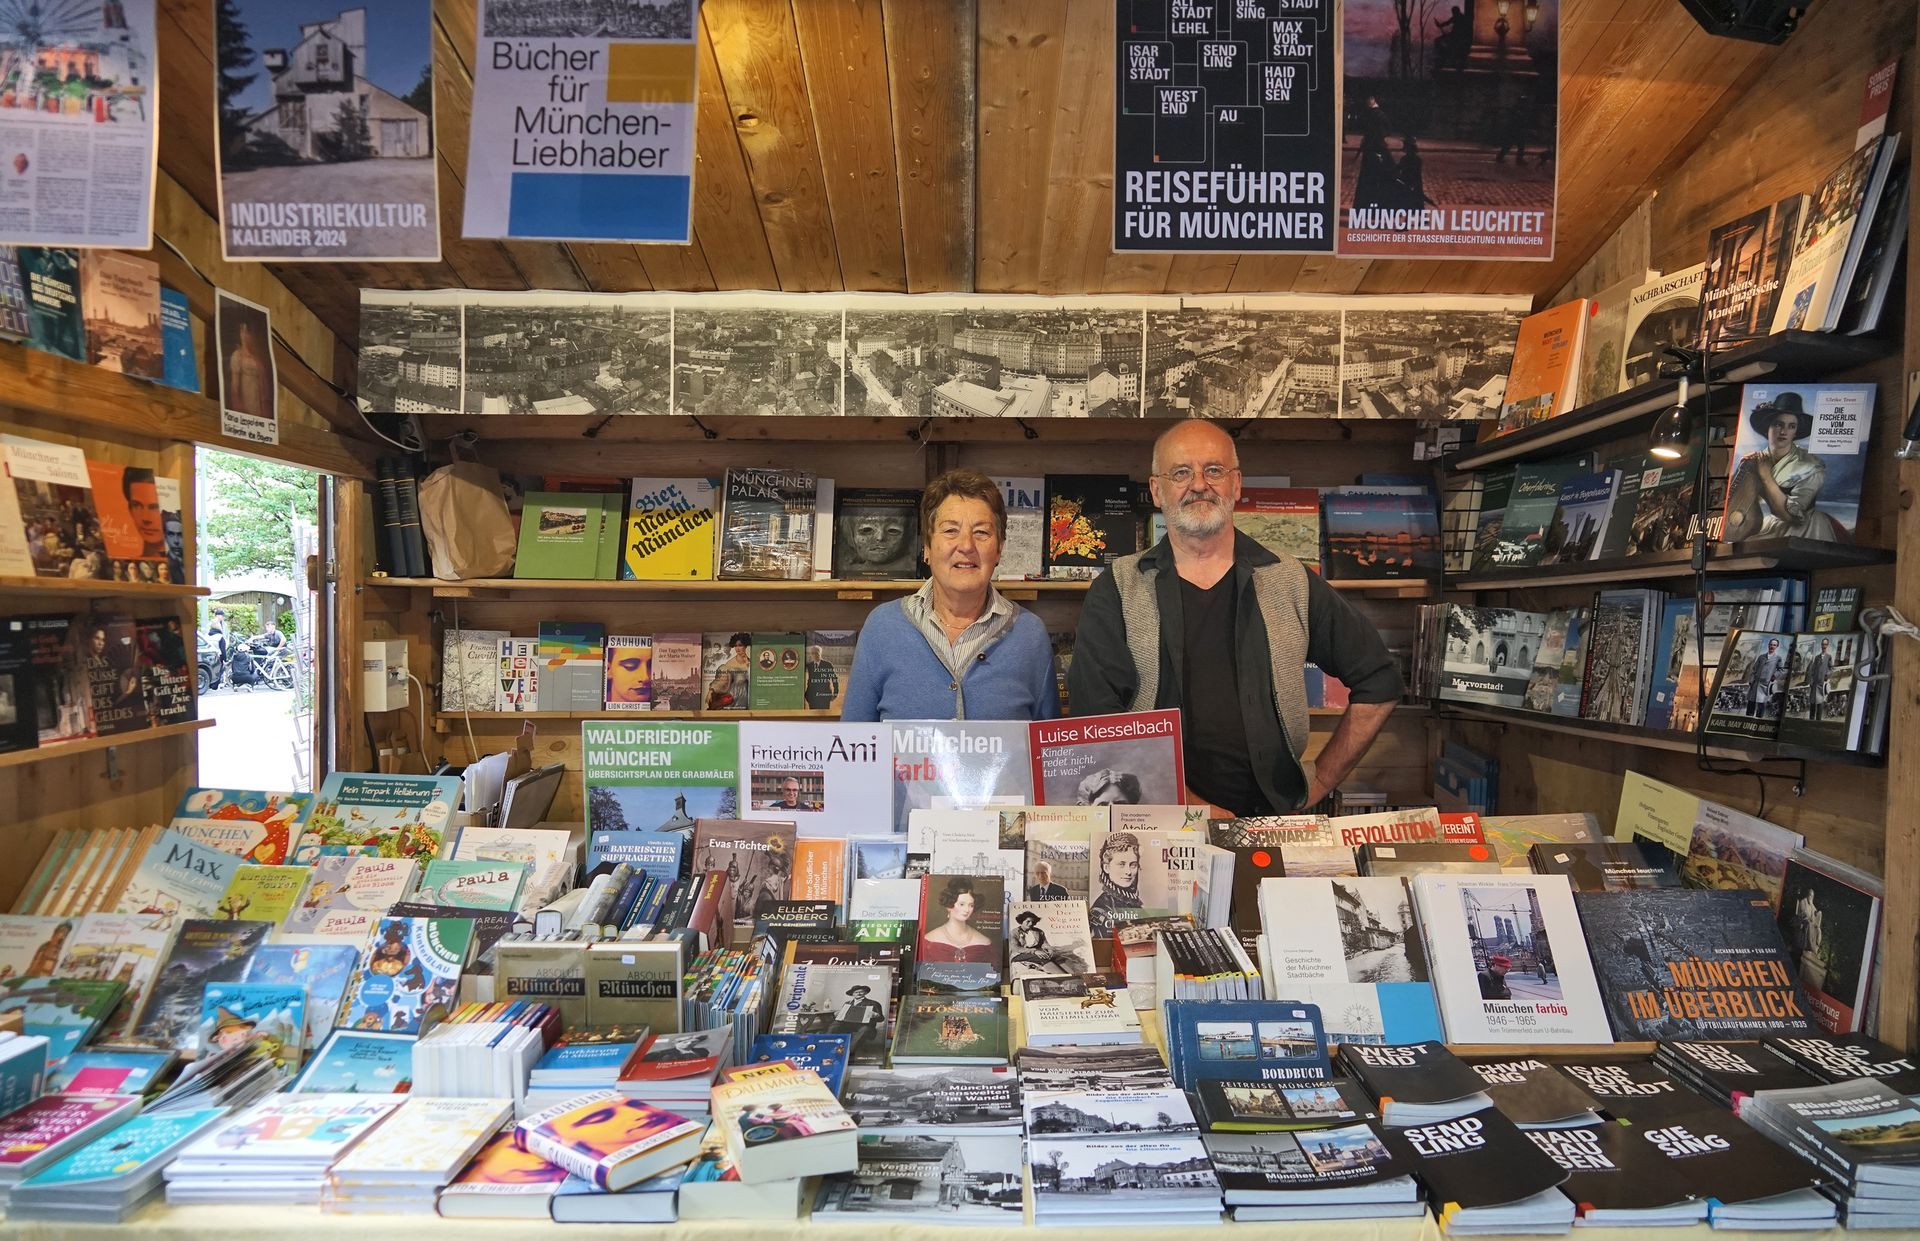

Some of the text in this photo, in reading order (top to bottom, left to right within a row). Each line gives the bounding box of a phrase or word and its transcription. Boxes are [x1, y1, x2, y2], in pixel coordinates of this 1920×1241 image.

[1172, 6, 1213, 18] STADT
[1236, 8, 1266, 19] SING
[1172, 22, 1208, 34] LEHEL
[1273, 22, 1302, 34] MAX
[1274, 33, 1298, 44] VOR
[492, 41, 600, 71] Bücher
[1130, 45, 1158, 57] ISAR
[1203, 45, 1237, 56] SEND
[1274, 45, 1314, 56] STADT
[1130, 57, 1155, 68] VOR
[1204, 56, 1232, 68] LING
[1130, 68, 1170, 80] STADT
[1265, 66, 1295, 78] HAID
[548, 74, 590, 103] für
[1266, 78, 1292, 89] HAU
[1160, 90, 1198, 102] WEST
[1265, 89, 1290, 101] SEN
[1162, 102, 1188, 114] END
[514, 106, 672, 136] München-
[1220, 110, 1238, 122] AU
[512, 138, 670, 168] Liebhaber
[1126, 163, 1325, 204] REISEFÜHRER
[232, 203, 427, 228] INDUSTRIEKULTUR
[1348, 203, 1544, 233] MÜNCHEN LEUCHTET
[1125, 205, 1324, 240] FÜR MÜNCHNER
[233, 229, 347, 247] KALENDER 2024
[1347, 233, 1544, 246] GESCHICHTE DER STRASSENBELEUCHTUNG IN MÜNCHEN
[1702, 278, 1754, 304] Münchens
[1731, 278, 1779, 304] magische
[1706, 303, 1745, 322] Mauern
[732, 472, 813, 490] MÜNCHNER
[731, 485, 779, 499] PALAIS
[636, 484, 682, 515] Bier.
[633, 496, 696, 536] Macht.
[632, 508, 714, 559] München
[1818, 588, 1856, 604] KARL MAY
[1822, 603, 1852, 613] München
[152, 666, 170, 676] Das
[154, 684, 186, 696] Gift der
[1452, 678, 1504, 692] Maxvorstadt
[160, 704, 187, 716] tracht
[1710, 718, 1757, 731] KARL MAY UND
[586, 730, 712, 745] WALDFRIEDHOF
[1038, 719, 1173, 744] Luise Kiesselbach
[892, 730, 1003, 754] München
[751, 735, 878, 763] Friedrich Ani
[588, 748, 672, 766] MÜNCHEN
[1042, 754, 1097, 768] redet nicht,
[751, 762, 806, 770] Krimifestival-Preis
[588, 769, 734, 780] ÜBERSICHTSPLAN DER GRABMÄLER
[1044, 768, 1057, 778] tut
[362, 787, 390, 798] Tierpark
[394, 788, 430, 797] Hellabrunn
[1026, 811, 1088, 822] Altmünchen
[176, 826, 253, 840] MÜNCHEN
[1249, 830, 1320, 844] SCHWARZE
[1341, 820, 1436, 846] REVOLUTION
[610, 845, 676, 854] BAYERISCHEN
[709, 838, 771, 852] Evas Töchter
[600, 854, 675, 863] SUFFRAGETTEN
[1040, 851, 1088, 860] BAYERN
[164, 843, 224, 882] Max
[356, 862, 396, 875] Paula
[456, 871, 510, 888] Paula
[778, 906, 815, 914] ELLEN
[1107, 910, 1139, 920] Sophie
[326, 914, 367, 927] Paula
[476, 916, 508, 925] AREAL
[856, 928, 901, 938] ANI
[536, 969, 580, 977] ABSOLUT
[627, 972, 672, 980] ABSOLUT
[1286, 971, 1325, 979] Stadtbäche
[1668, 956, 1791, 988] MÜNCHEN
[509, 978, 580, 994] München
[601, 981, 672, 996] München
[787, 966, 808, 1010] Originale
[917, 1002, 994, 1014] FLÖSSERN
[1483, 1003, 1568, 1016] München farbig
[1627, 987, 1804, 1020] IM ÜBERBLICK
[1696, 1020, 1767, 1029] LUFTBILDAUFNAHMEN
[1672, 1042, 1730, 1054] NEU
[1776, 1037, 1834, 1050] LUD
[1353, 1044, 1429, 1058] WEST
[1788, 1045, 1870, 1058] WIGS
[1361, 1056, 1416, 1066] END
[1688, 1052, 1742, 1064] HAU
[1262, 1067, 1324, 1080] BORDBUCH
[1563, 1065, 1630, 1076] ISAR
[1700, 1060, 1760, 1074] SEN
[1824, 1059, 1916, 1077] STADT
[1574, 1074, 1635, 1086] VOR
[1588, 1080, 1676, 1096] STADT
[526, 1089, 617, 1127] SAUHUND
[1788, 1094, 1883, 1110] Münchner
[1796, 1098, 1901, 1117] Bergführer
[257, 1103, 392, 1116] MÜNCHEN
[249, 1114, 374, 1144] ABC
[1403, 1117, 1484, 1143] SEND
[1644, 1125, 1694, 1144] GIE
[1524, 1128, 1599, 1144] HAID
[1412, 1131, 1486, 1156] LING
[1536, 1142, 1604, 1156] HAU
[1657, 1134, 1731, 1156] SING
[880, 1163, 940, 1171] Verlorene
[1550, 1154, 1616, 1170] SEN
[1265, 1165, 1376, 1181] München Ortstermin
